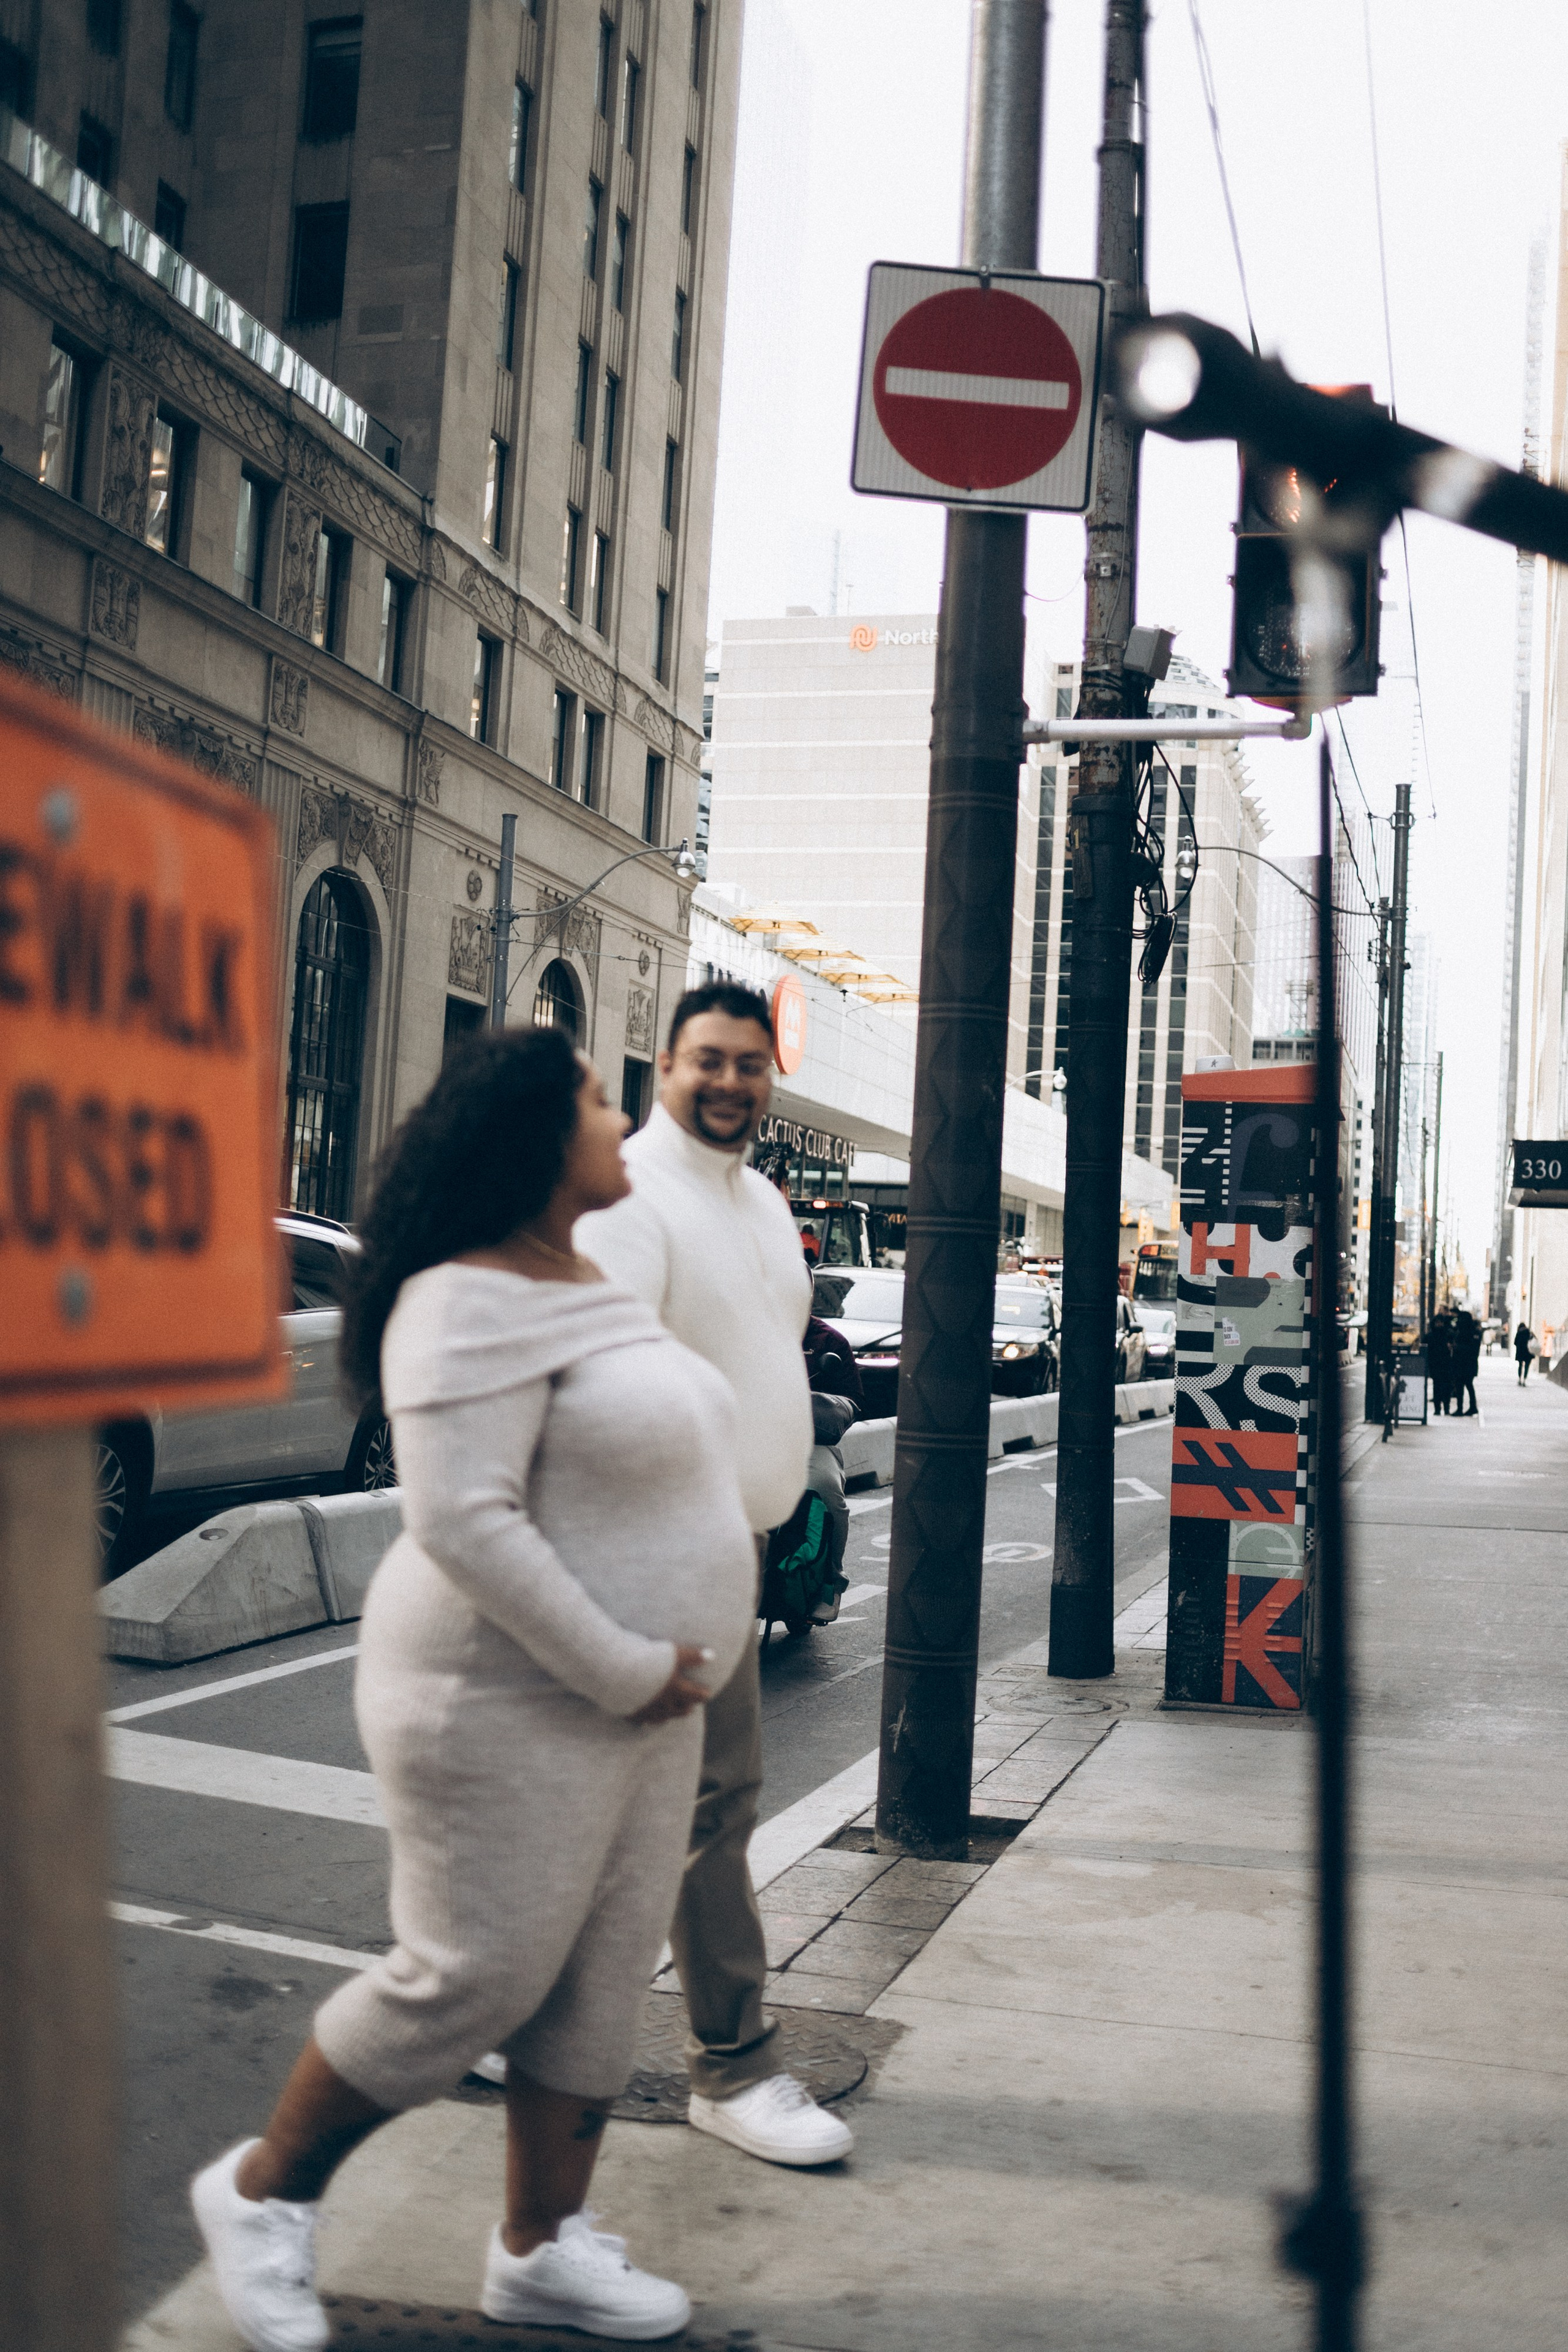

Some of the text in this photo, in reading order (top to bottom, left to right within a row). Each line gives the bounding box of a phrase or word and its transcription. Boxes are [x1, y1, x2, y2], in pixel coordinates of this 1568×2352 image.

[758, 1115, 804, 1152] CACTUS
[805, 1129, 831, 1159] CLUB
[1521, 1159, 1562, 1180] 330
